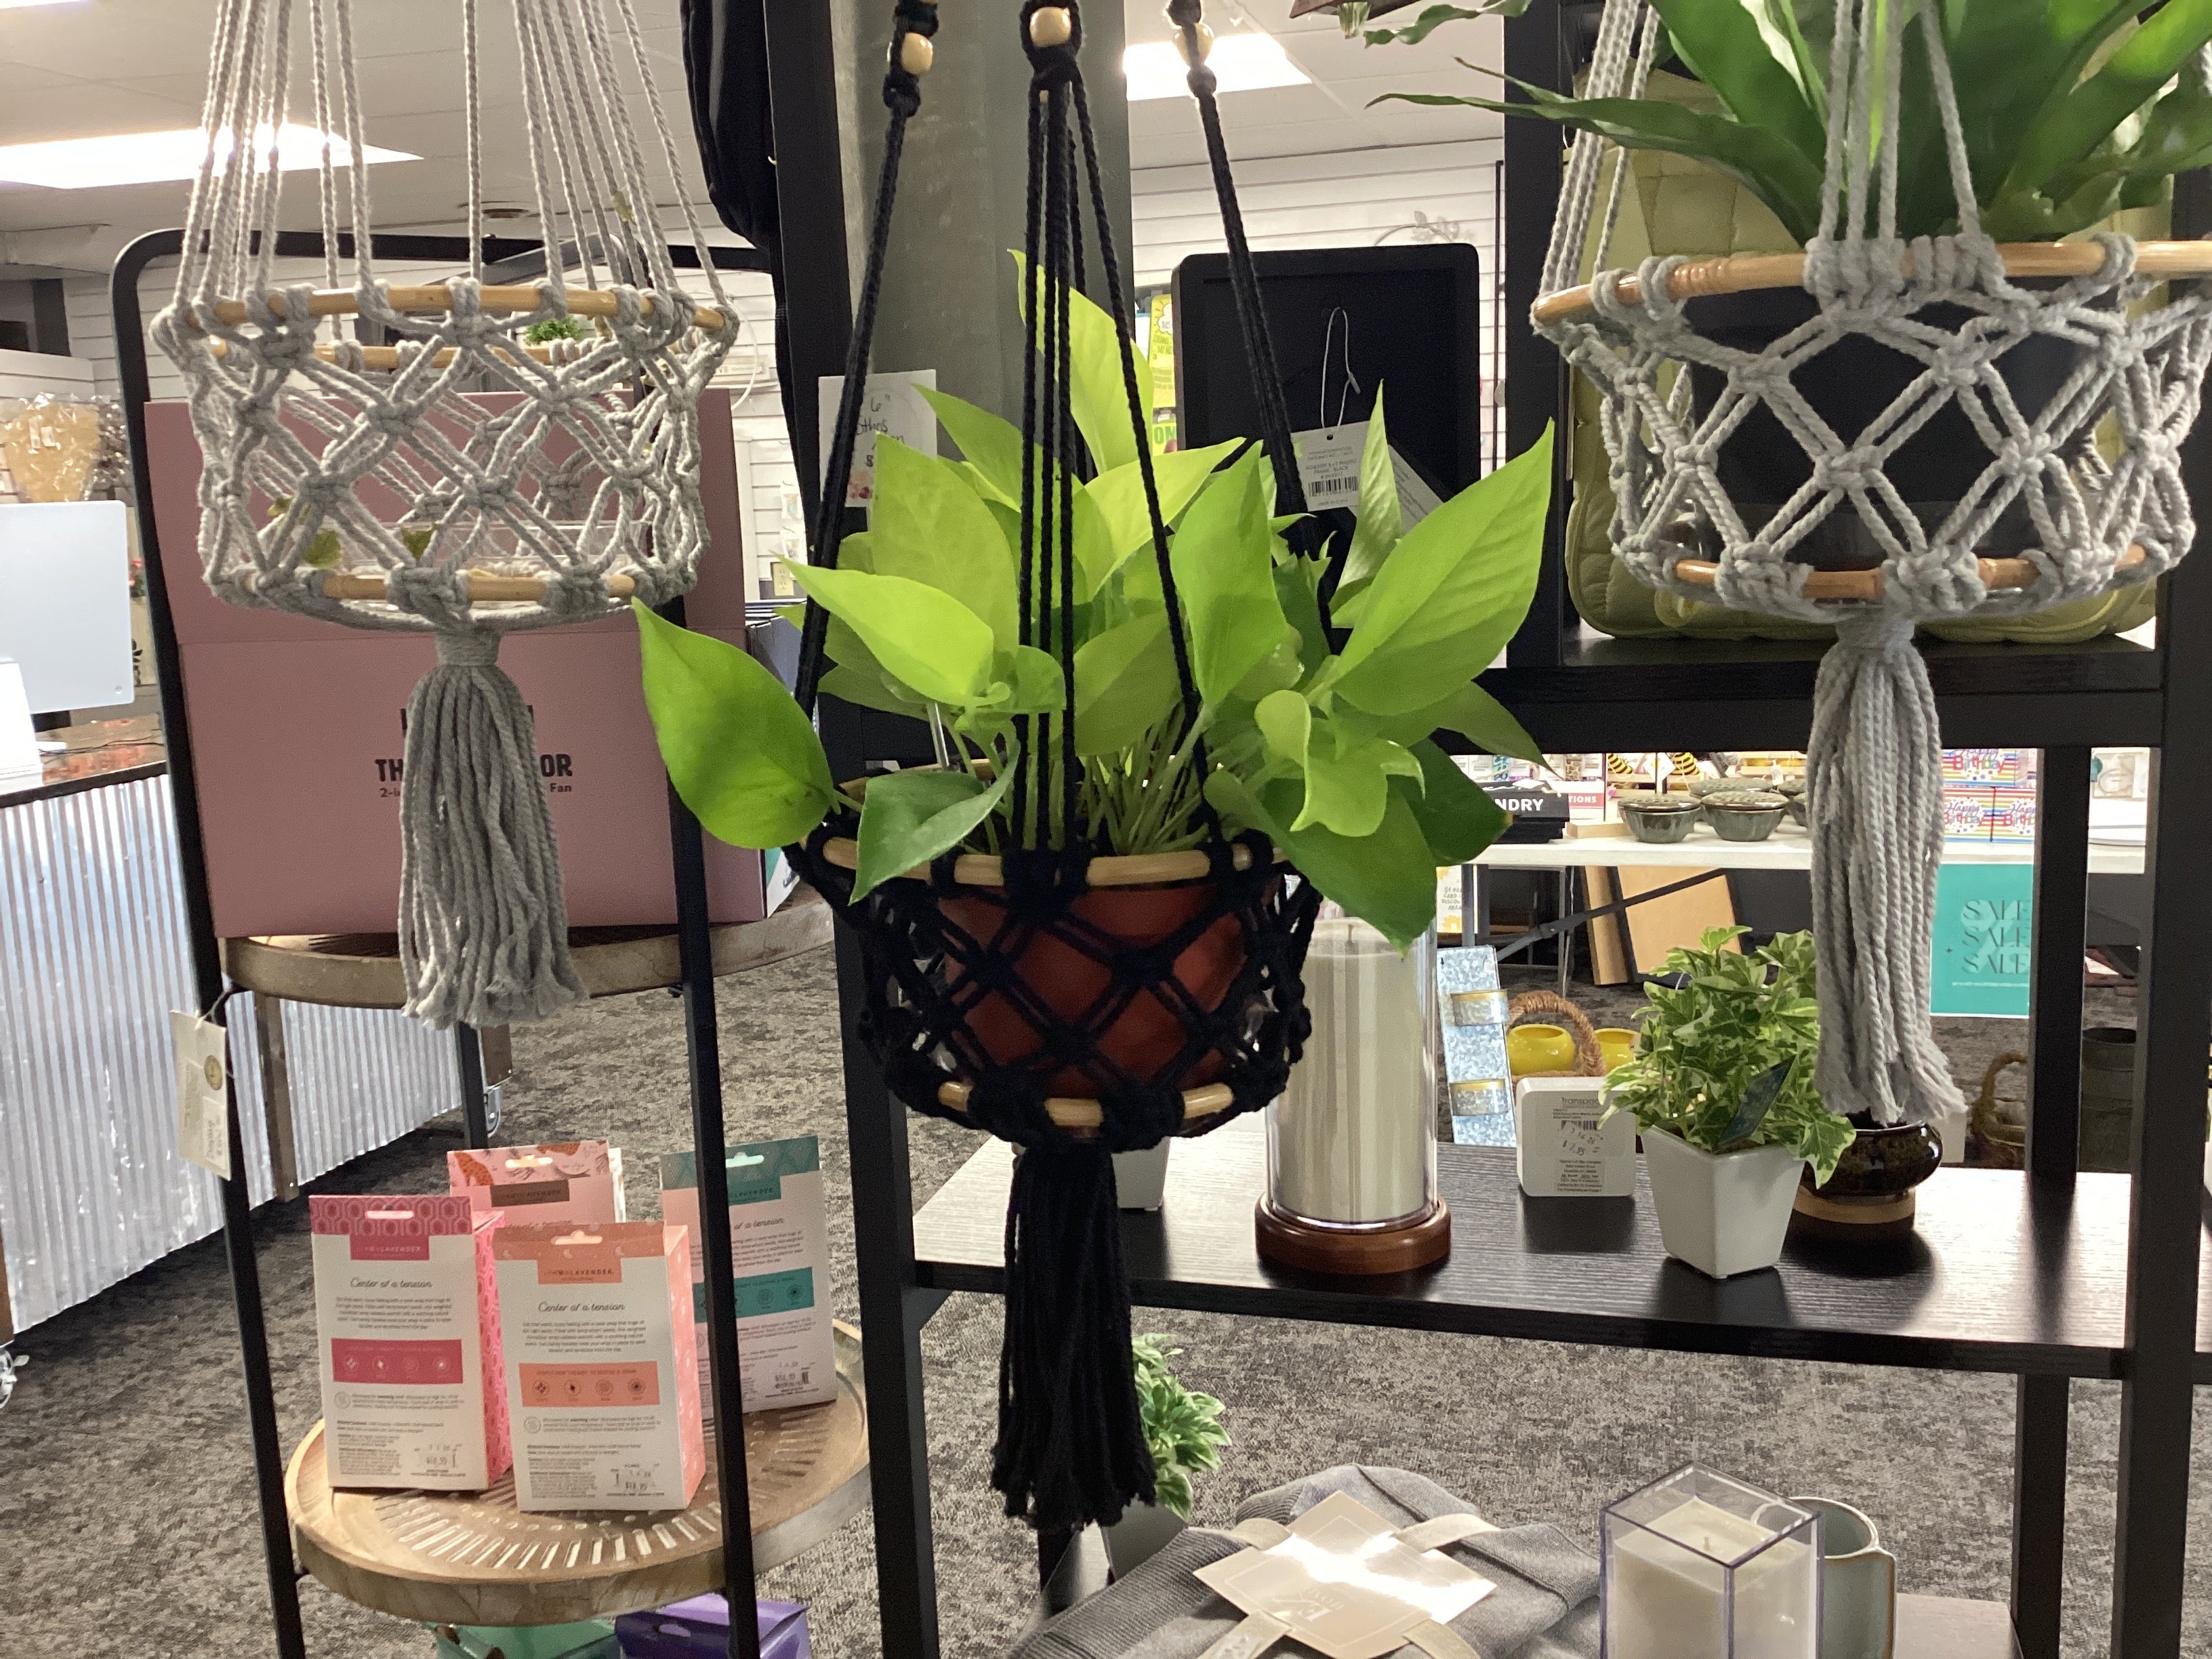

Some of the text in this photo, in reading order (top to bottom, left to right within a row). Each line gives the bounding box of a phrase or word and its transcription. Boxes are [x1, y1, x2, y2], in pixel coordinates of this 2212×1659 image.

[1952, 755, 2005, 774] Birthday
[550, 783, 572, 792] Fan
[1494, 798, 1544, 811] NDRY
[350, 1277, 378, 1288] Center
[380, 1279, 390, 1288] of
[538, 1301, 567, 1312] Center
[570, 1303, 580, 1311] of
[589, 1303, 626, 1311] tension
